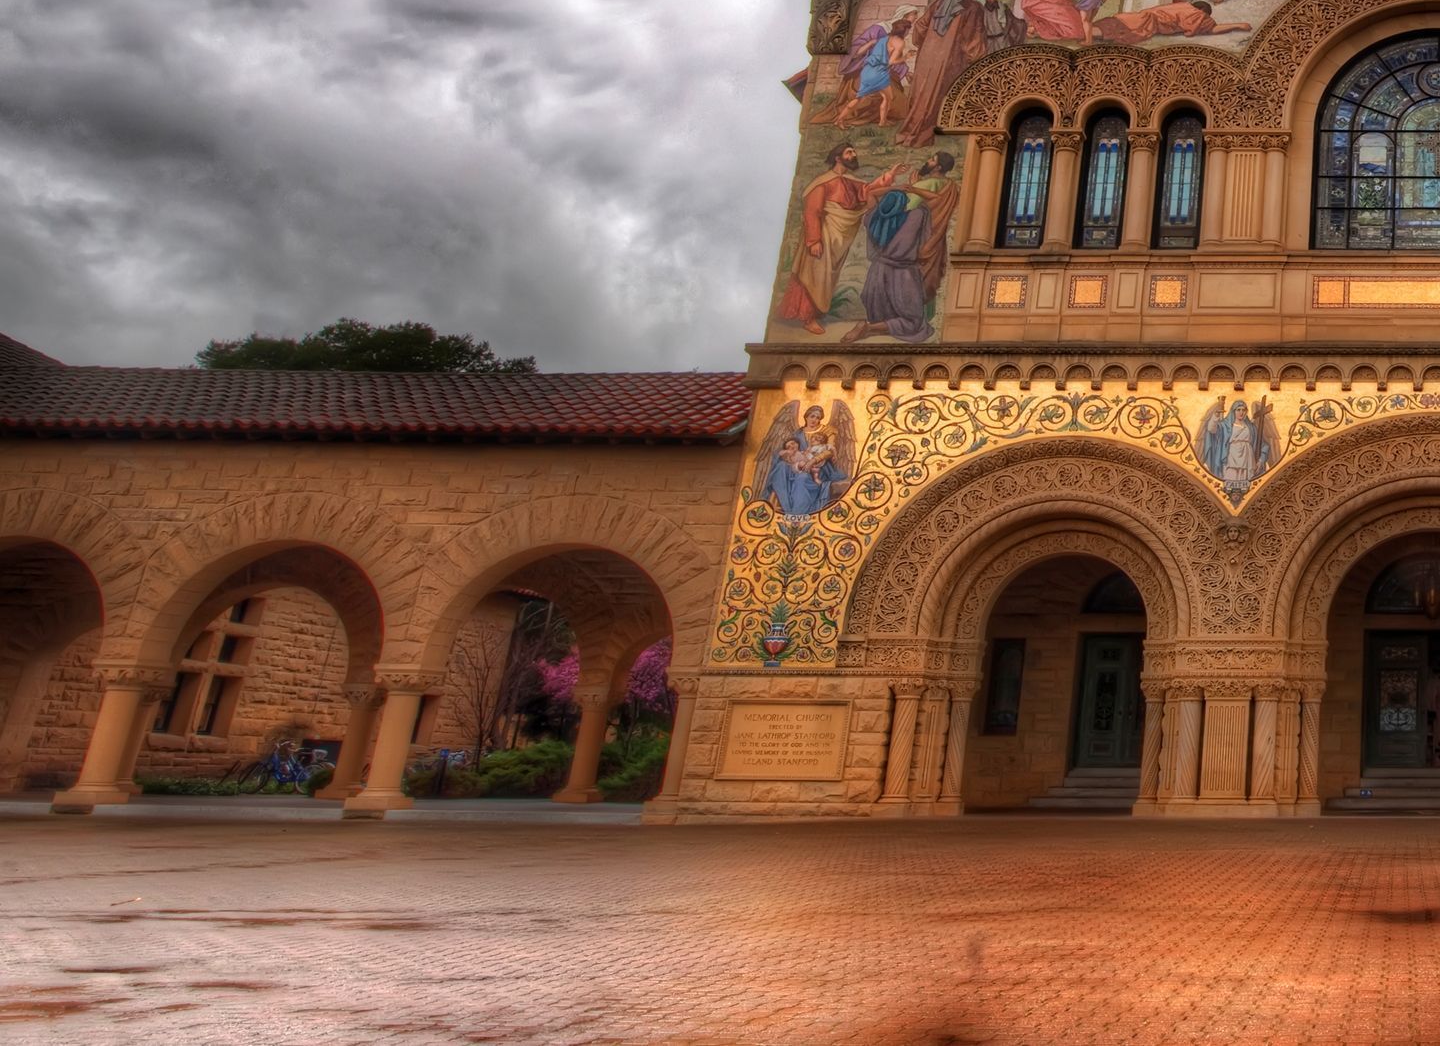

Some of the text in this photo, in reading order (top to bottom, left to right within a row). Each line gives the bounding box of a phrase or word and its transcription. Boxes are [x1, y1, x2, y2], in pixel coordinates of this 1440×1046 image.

[744, 714, 832, 722] MEMORIAL CHURCH
[758, 732, 791, 740] LATHROP
[794, 732, 836, 740] STANFORD
[777, 758, 819, 766] STANFORD
